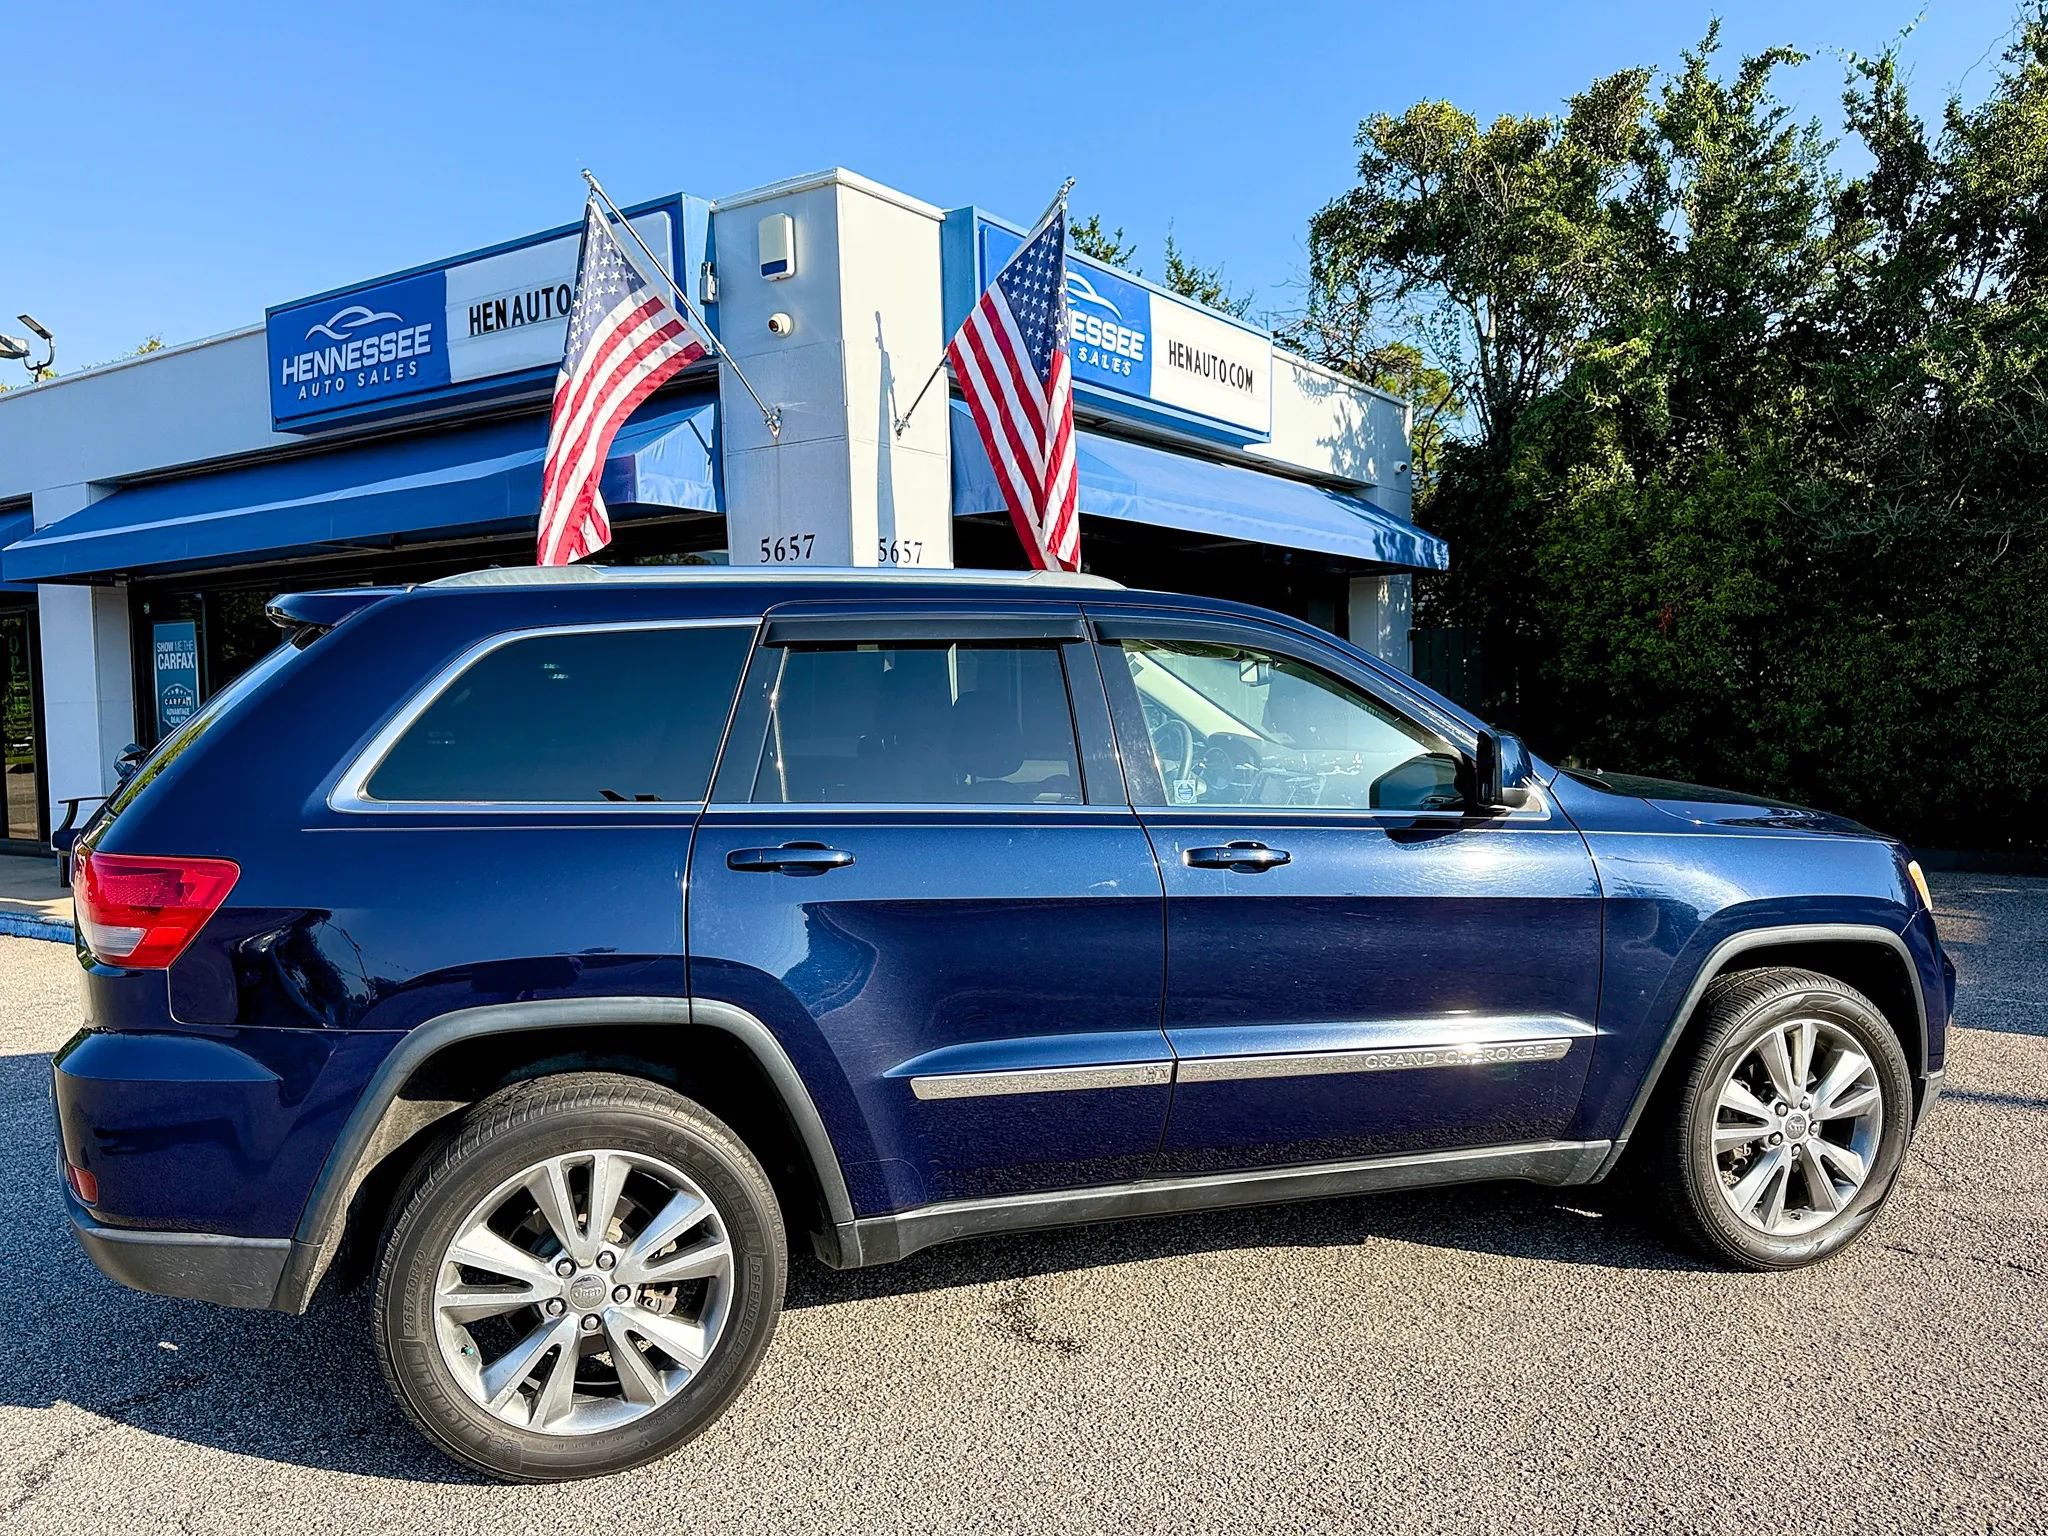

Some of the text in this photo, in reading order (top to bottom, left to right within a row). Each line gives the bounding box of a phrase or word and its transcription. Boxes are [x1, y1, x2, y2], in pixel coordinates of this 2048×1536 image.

[469, 283, 571, 336] HENAUTO
[1067, 307, 1146, 362] ESSEE
[282, 323, 432, 385] HENNESSEE
[1077, 346, 1133, 378] SALES
[299, 361, 417, 400] AUTO SALES
[760, 534, 816, 563] 5657
[877, 536, 923, 564] 5657
[157, 642, 174, 652] SHOW
[158, 652, 195, 670] CARFAX
[1365, 1045, 1546, 1069] GRAND CHEROKEE
[741, 1263, 762, 1339] DEFENDER
